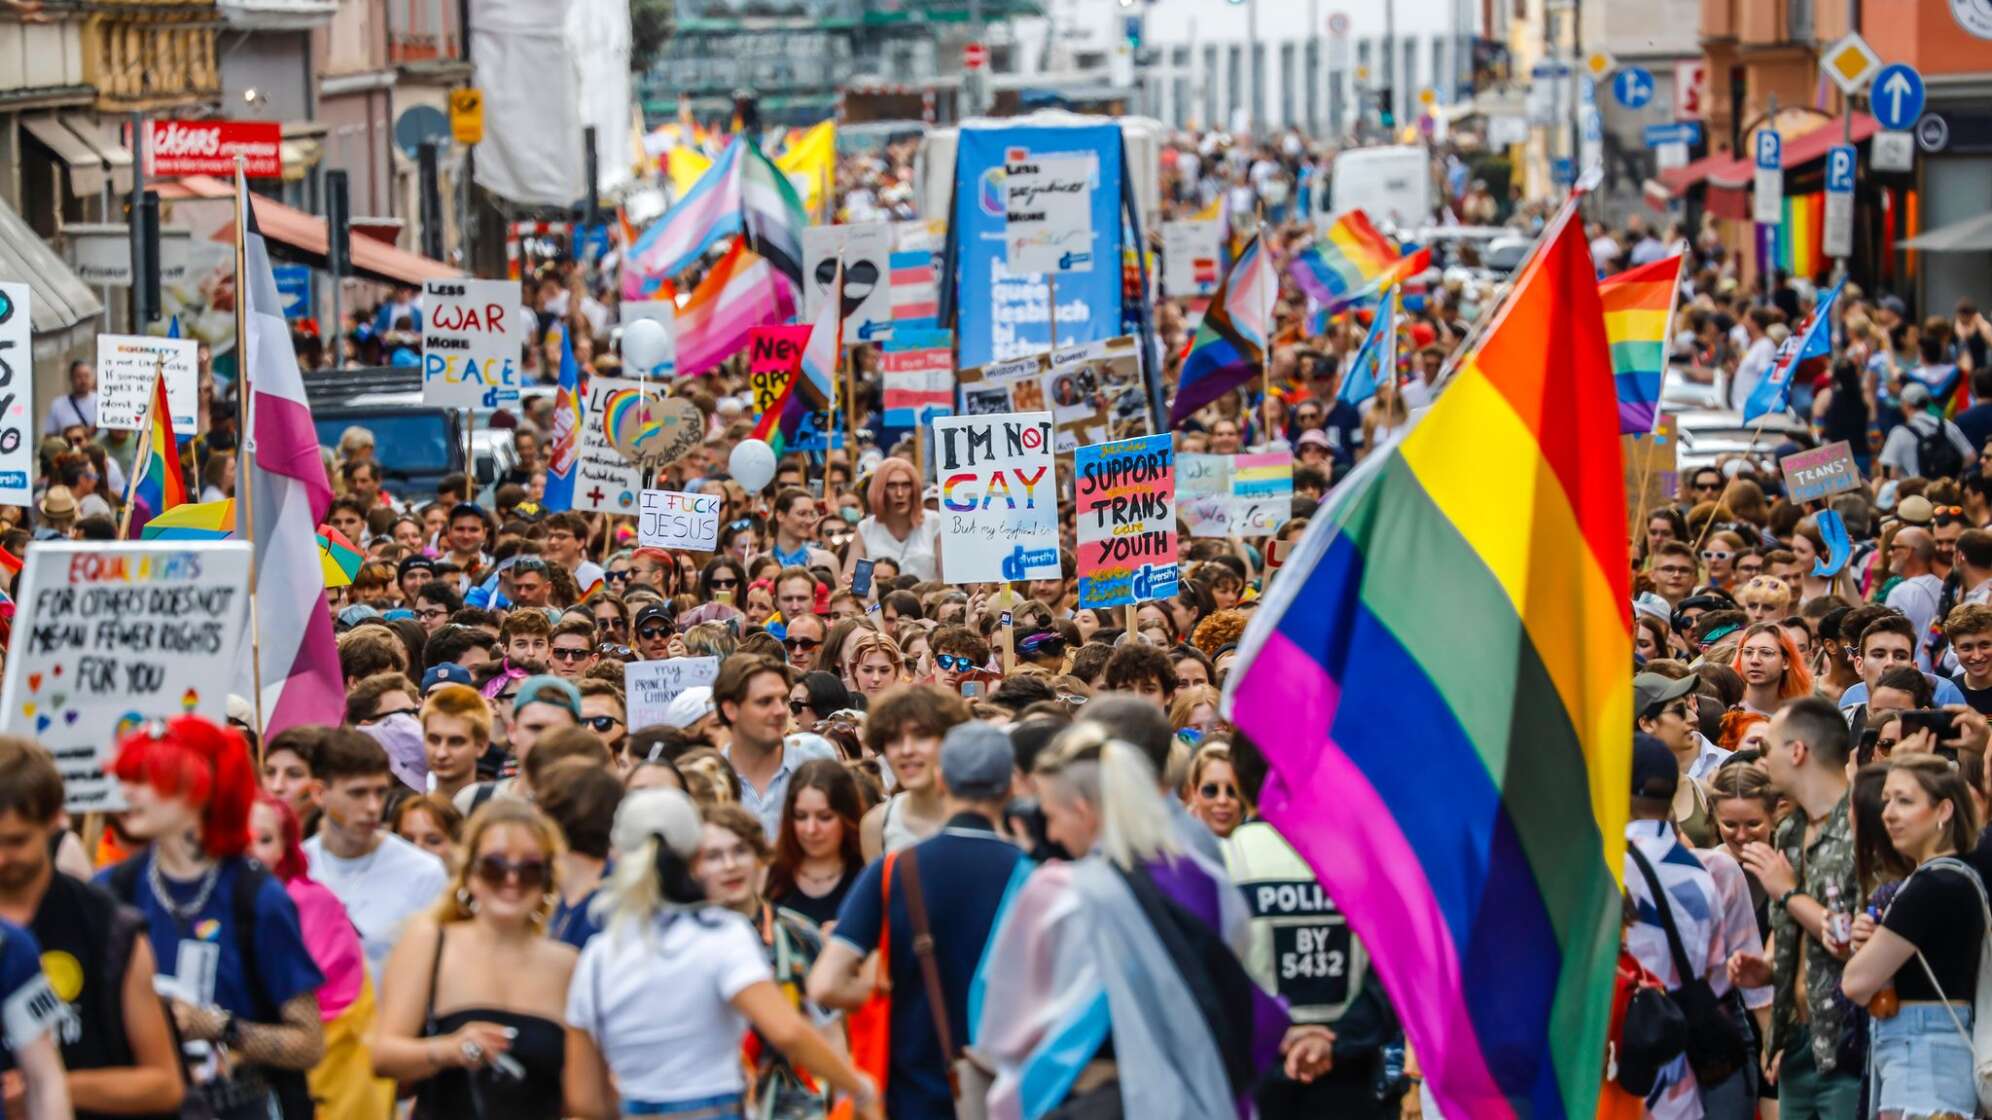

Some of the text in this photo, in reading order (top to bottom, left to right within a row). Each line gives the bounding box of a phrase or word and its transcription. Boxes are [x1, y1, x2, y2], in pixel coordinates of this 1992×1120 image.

[1833, 151, 1850, 186] P
[433, 304, 505, 333] WAR
[426, 353, 514, 385] PEACE
[941, 423, 996, 470] I'M
[943, 465, 1048, 513] GAY
[1082, 449, 1169, 496] SUPPORT
[643, 493, 719, 514] I FUCK
[1090, 491, 1168, 529] TRANS
[643, 512, 715, 541] JESUS
[1098, 530, 1168, 565] YOUTH
[68, 552, 131, 585] EQUAL
[36, 587, 76, 618] FOR
[149, 586, 195, 612] DOES
[198, 586, 235, 616] NOT
[28, 622, 87, 655] MEAN
[75, 655, 166, 694] FOR YOU
[1296, 927, 1330, 954] BY
[1281, 950, 1344, 979] 5432
